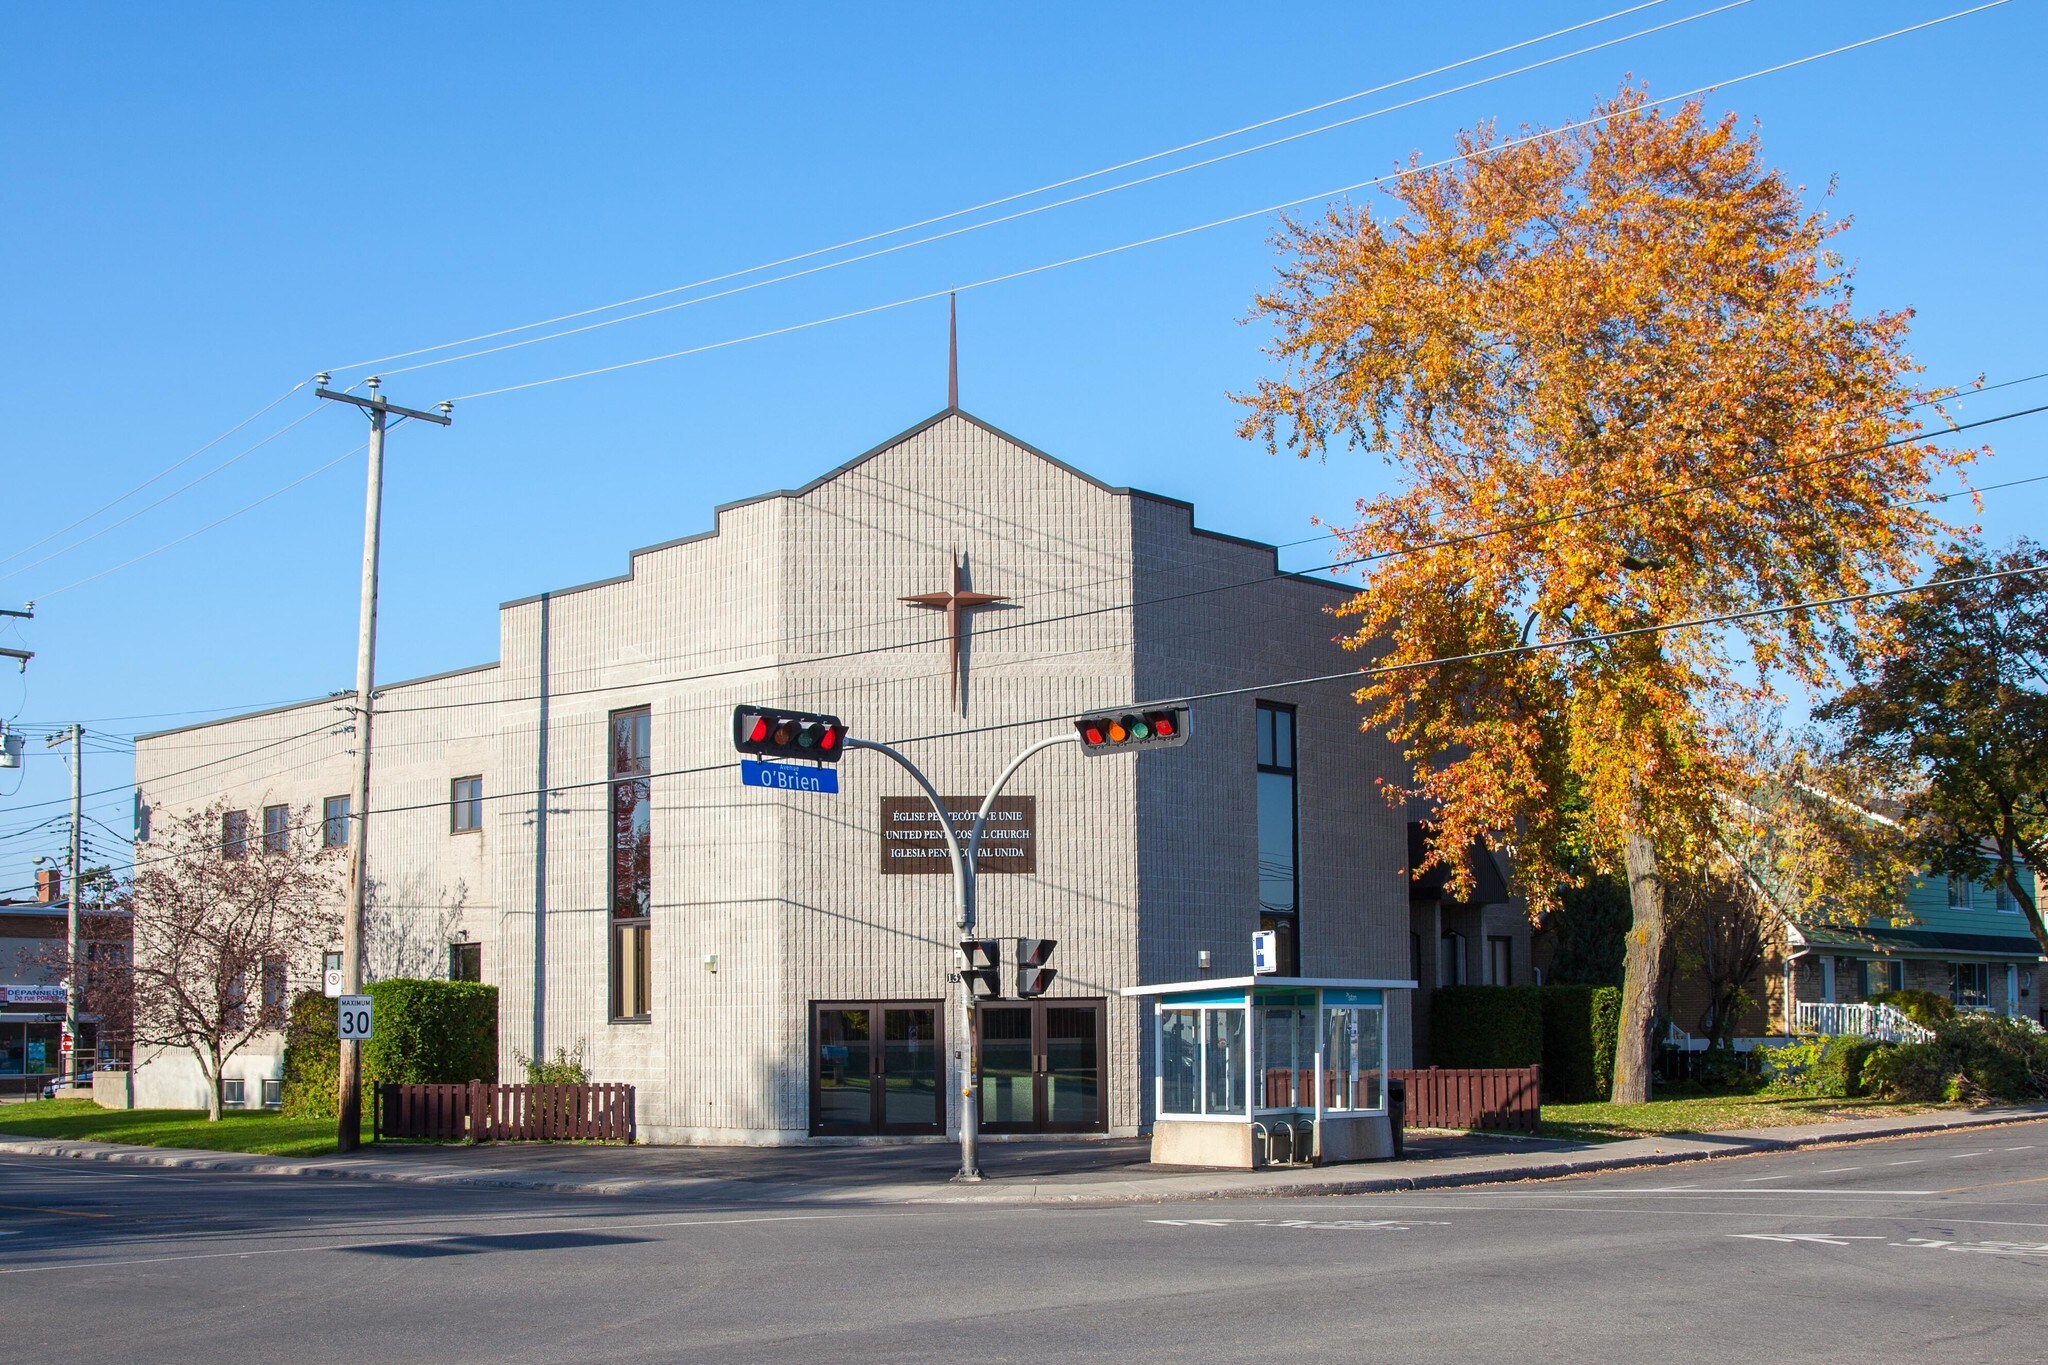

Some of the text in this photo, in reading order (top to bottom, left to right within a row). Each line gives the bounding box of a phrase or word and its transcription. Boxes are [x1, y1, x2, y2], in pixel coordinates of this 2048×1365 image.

[761, 770, 820, 791] O'Brien
[893, 810, 1023, 821] ÉGLISE PEECÔTTE UNIE
[886, 829, 1030, 840] UNITED PENTCOSL CHURCH
[891, 848, 927, 858] IGLESIA
[994, 848, 1025, 857] UNIDA
[7, 988, 65, 996] DÉPANNEUR
[342, 1011, 370, 1034] 30
